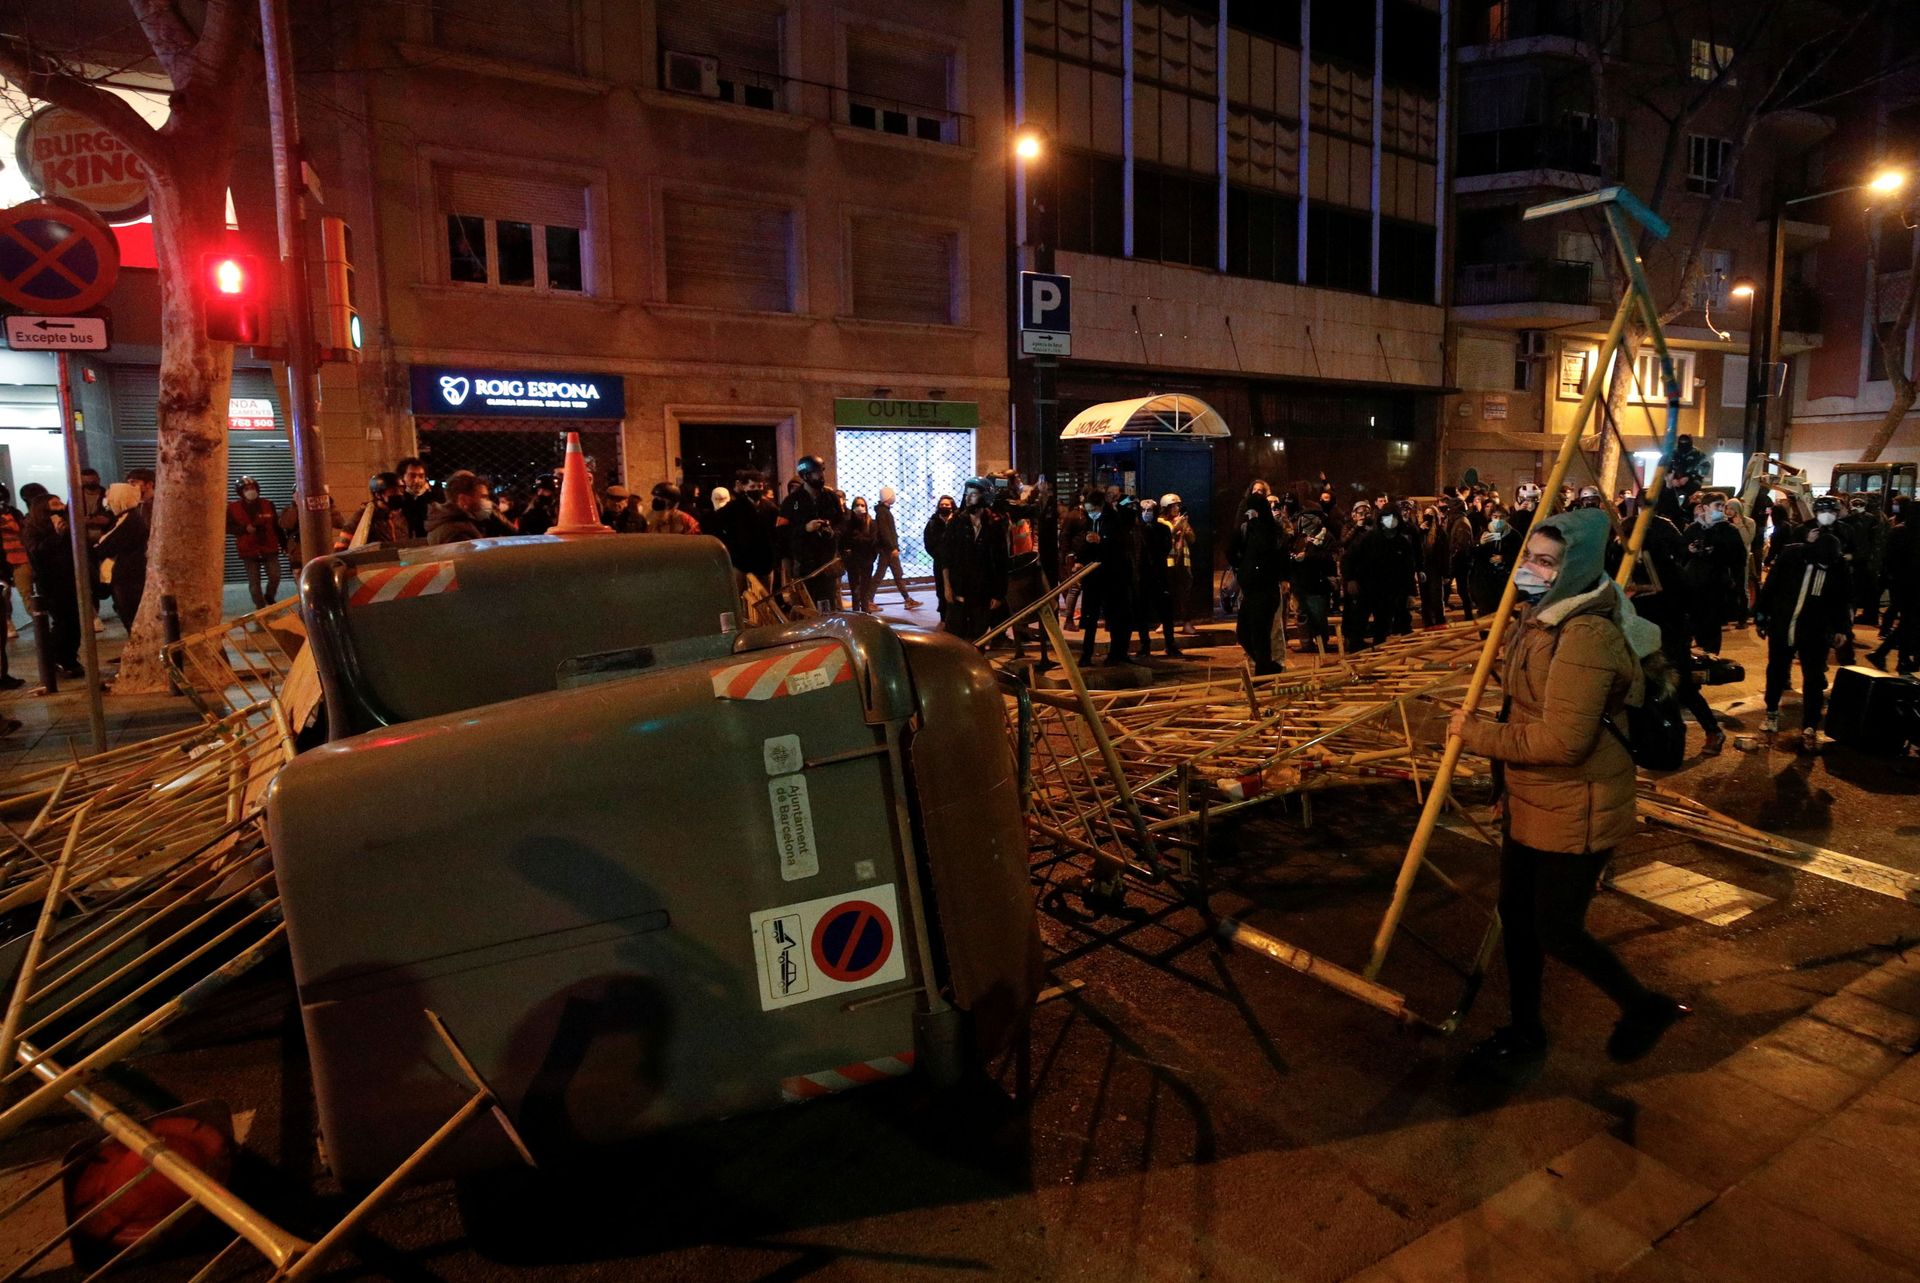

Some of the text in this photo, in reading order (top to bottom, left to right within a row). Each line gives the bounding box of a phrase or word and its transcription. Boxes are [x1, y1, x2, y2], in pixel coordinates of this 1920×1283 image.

[34, 131, 127, 160] BURG
[1032, 280, 1062, 324] P
[15, 332, 94, 344] Excepte bus
[475, 379, 600, 399] ROIG ESPONA
[231, 400, 258, 408] NDA
[868, 401, 940, 418] OUTLET
[776, 787, 796, 866] de Barcelona
[788, 785, 809, 855] Ajuntament
